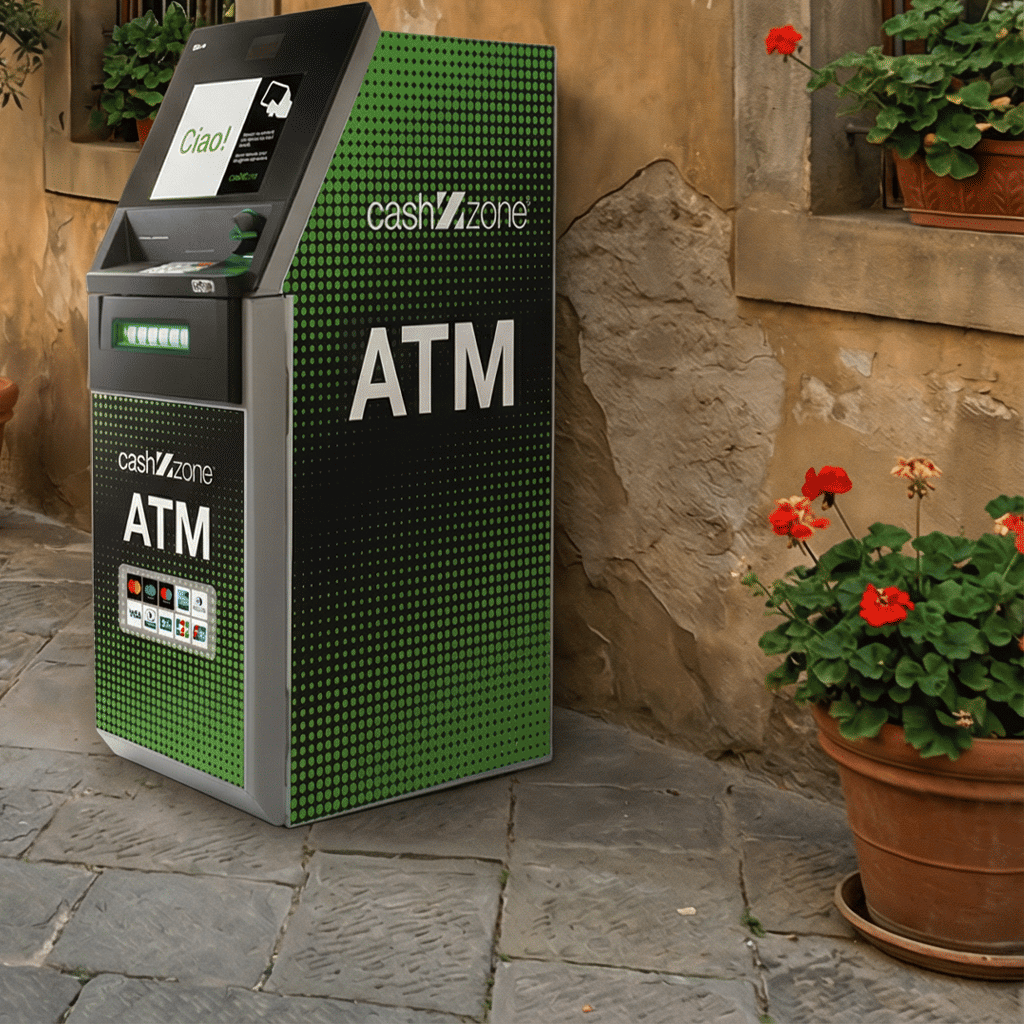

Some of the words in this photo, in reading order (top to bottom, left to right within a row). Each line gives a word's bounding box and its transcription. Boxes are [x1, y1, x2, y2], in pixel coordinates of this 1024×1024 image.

[180, 125, 232, 154] Ciao!
[348, 319, 515, 422] ATM
[123, 492, 211, 561] ATM
